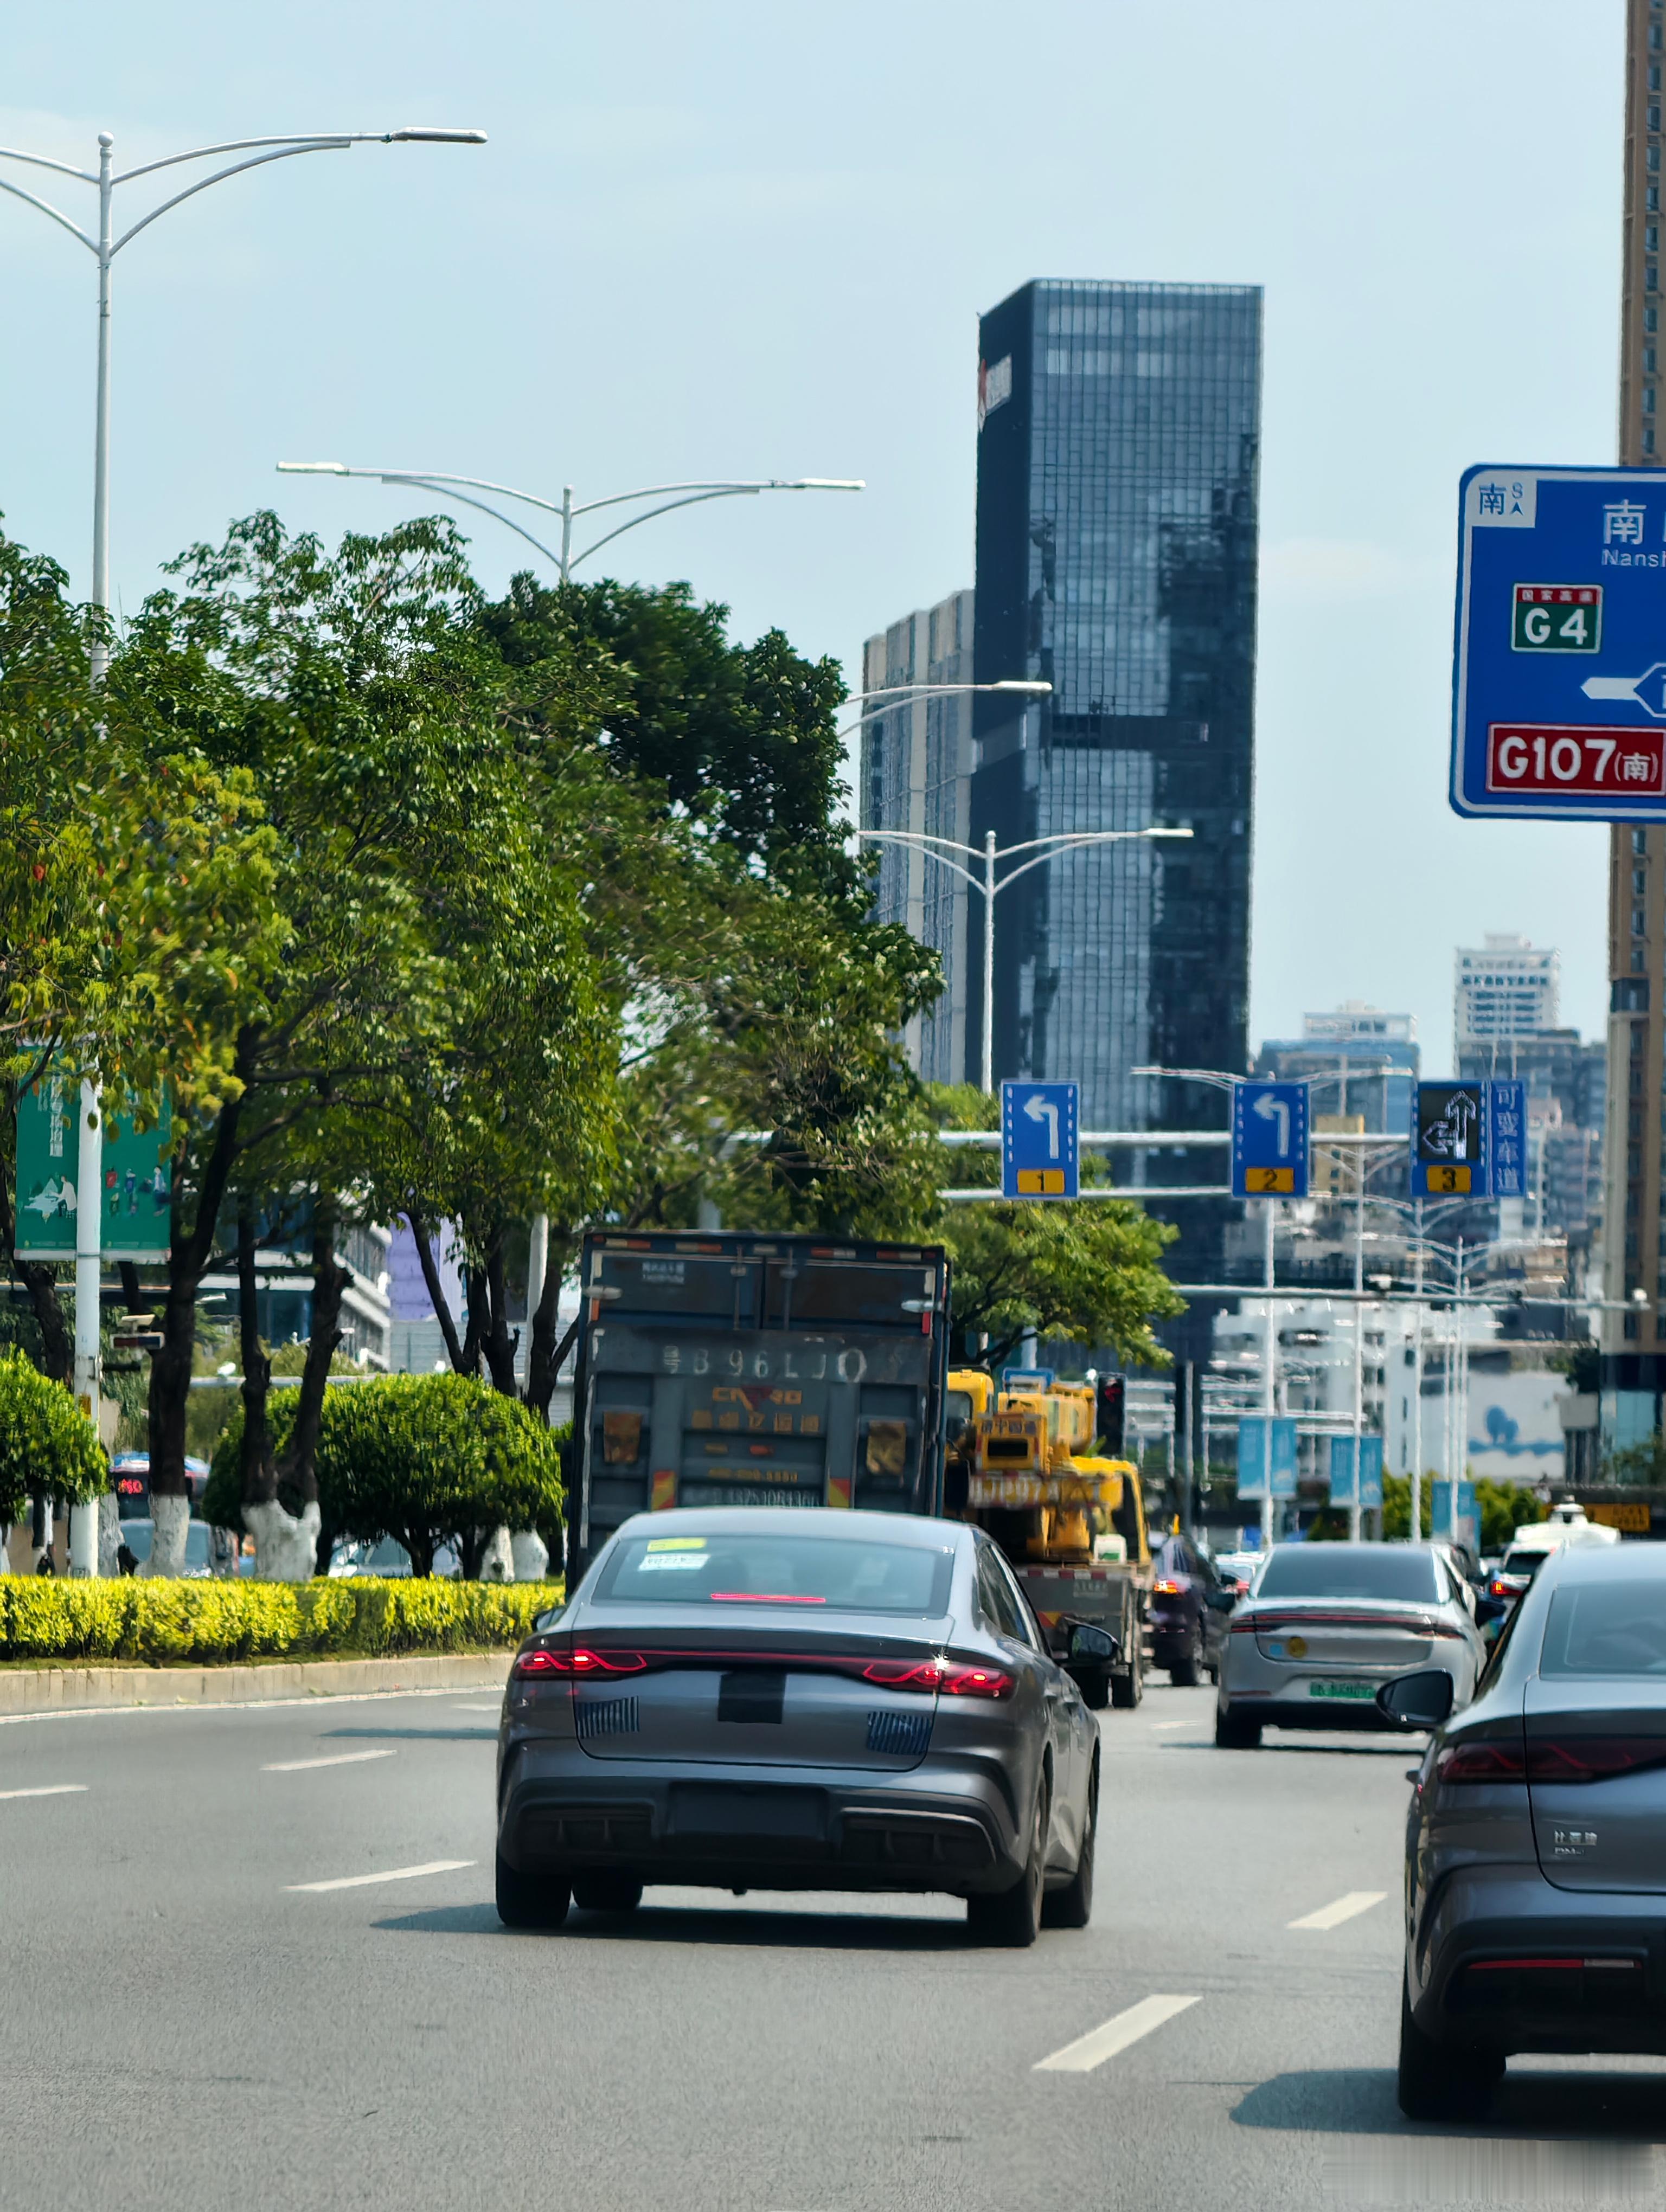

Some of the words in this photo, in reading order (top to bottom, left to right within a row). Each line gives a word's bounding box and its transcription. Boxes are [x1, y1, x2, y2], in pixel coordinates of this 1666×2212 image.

[1479, 482, 1507, 515] 南
[1512, 481, 1523, 499] S
[1603, 498, 1666, 544] 南
[1037, 1171, 1045, 1192] 1
[1263, 1168, 1278, 1191] 2
[1442, 1167, 1456, 1191] 3
